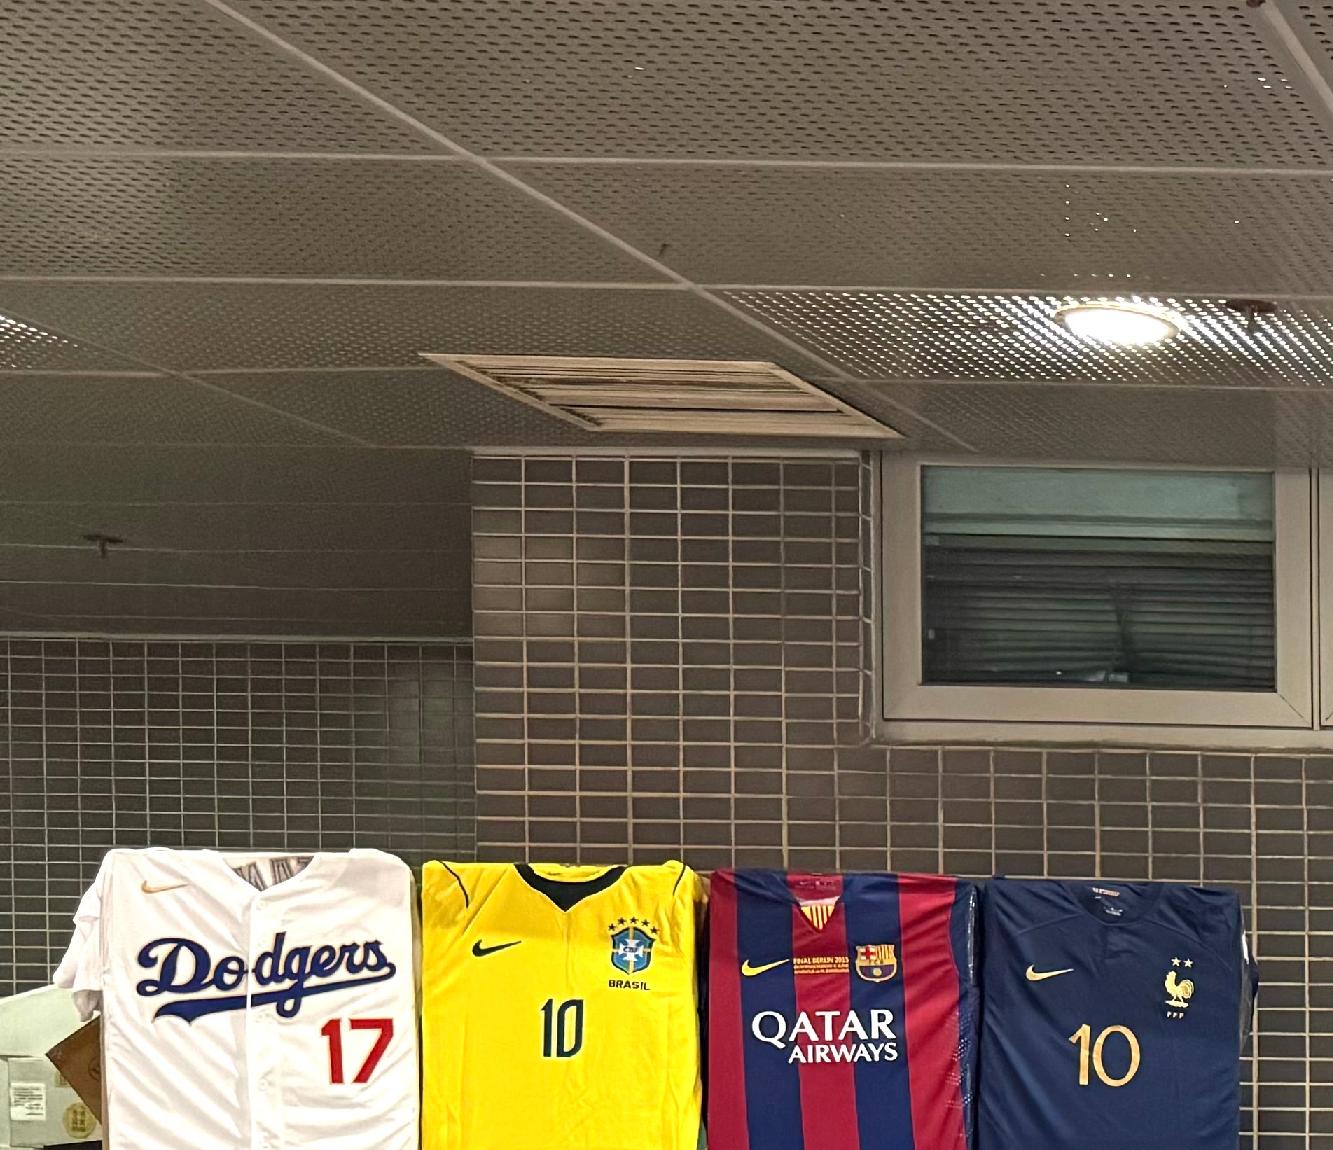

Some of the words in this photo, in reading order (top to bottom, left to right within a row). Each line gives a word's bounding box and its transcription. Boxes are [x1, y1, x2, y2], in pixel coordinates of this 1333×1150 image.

[137, 932, 396, 1022] Dodgers
[608, 979, 651, 991] BRASIL
[320, 1017, 395, 1085] 17
[541, 998, 585, 1058] 10
[751, 1010, 897, 1051] QATAR
[788, 1041, 899, 1064] AIRWAYS
[1068, 1023, 1141, 1088] 10
